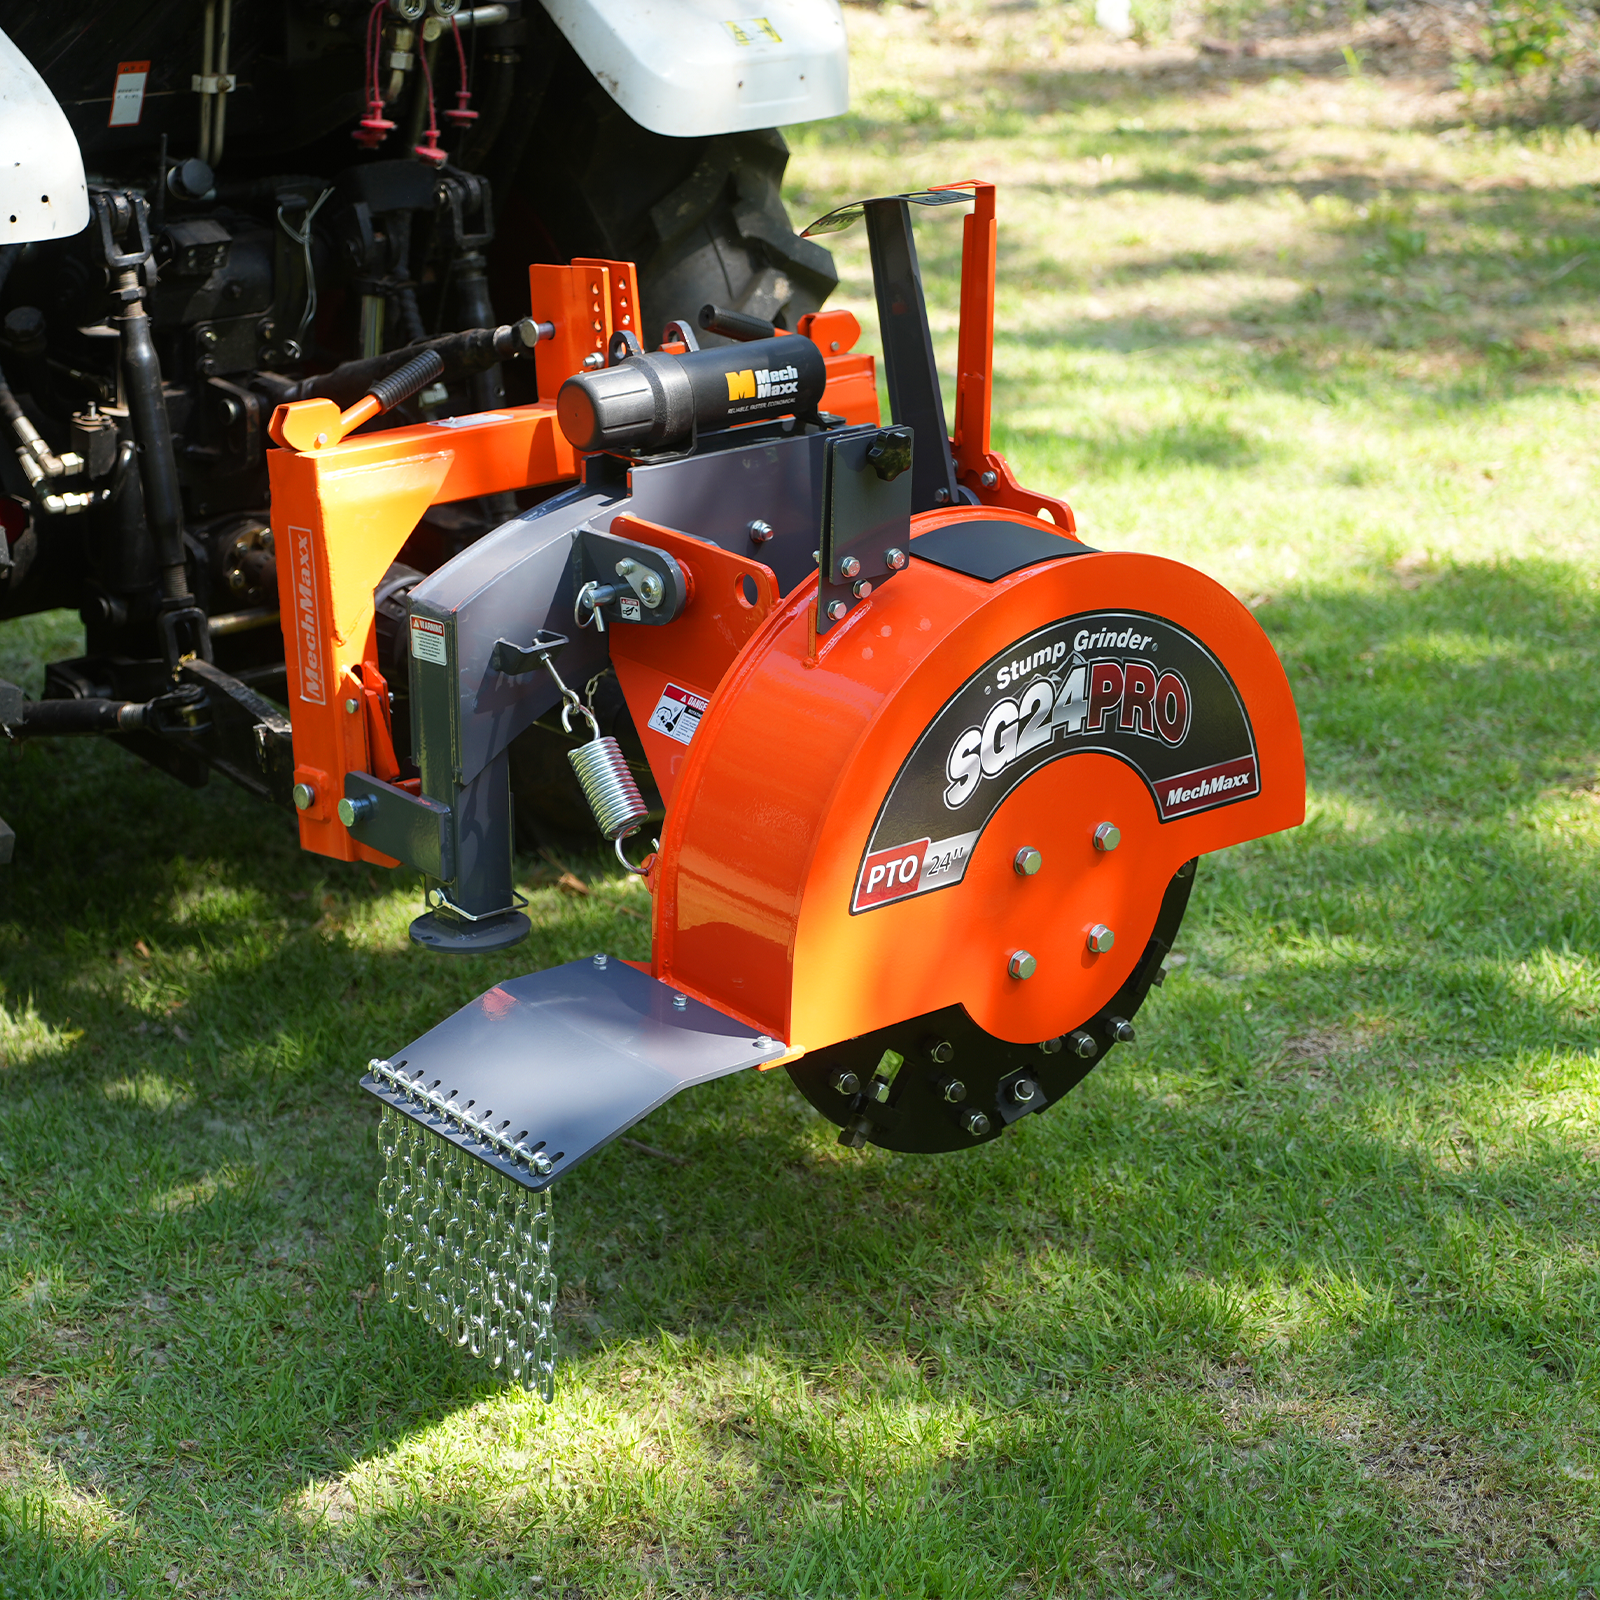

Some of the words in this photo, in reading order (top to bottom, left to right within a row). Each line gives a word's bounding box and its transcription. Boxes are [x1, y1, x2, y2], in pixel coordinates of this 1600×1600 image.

[755, 366, 798, 384] Mech
[757, 381, 798, 399] Maxx
[298, 534, 321, 698] MechMaxx
[420, 620, 443, 634] WARNING
[996, 641, 1066, 690] Stump
[1073, 627, 1152, 652] Grinder
[687, 696, 709, 712] DANGE
[943, 657, 1192, 810] SG24PRO
[1166, 772, 1250, 807] MechMaxx
[866, 854, 918, 894] PTO
